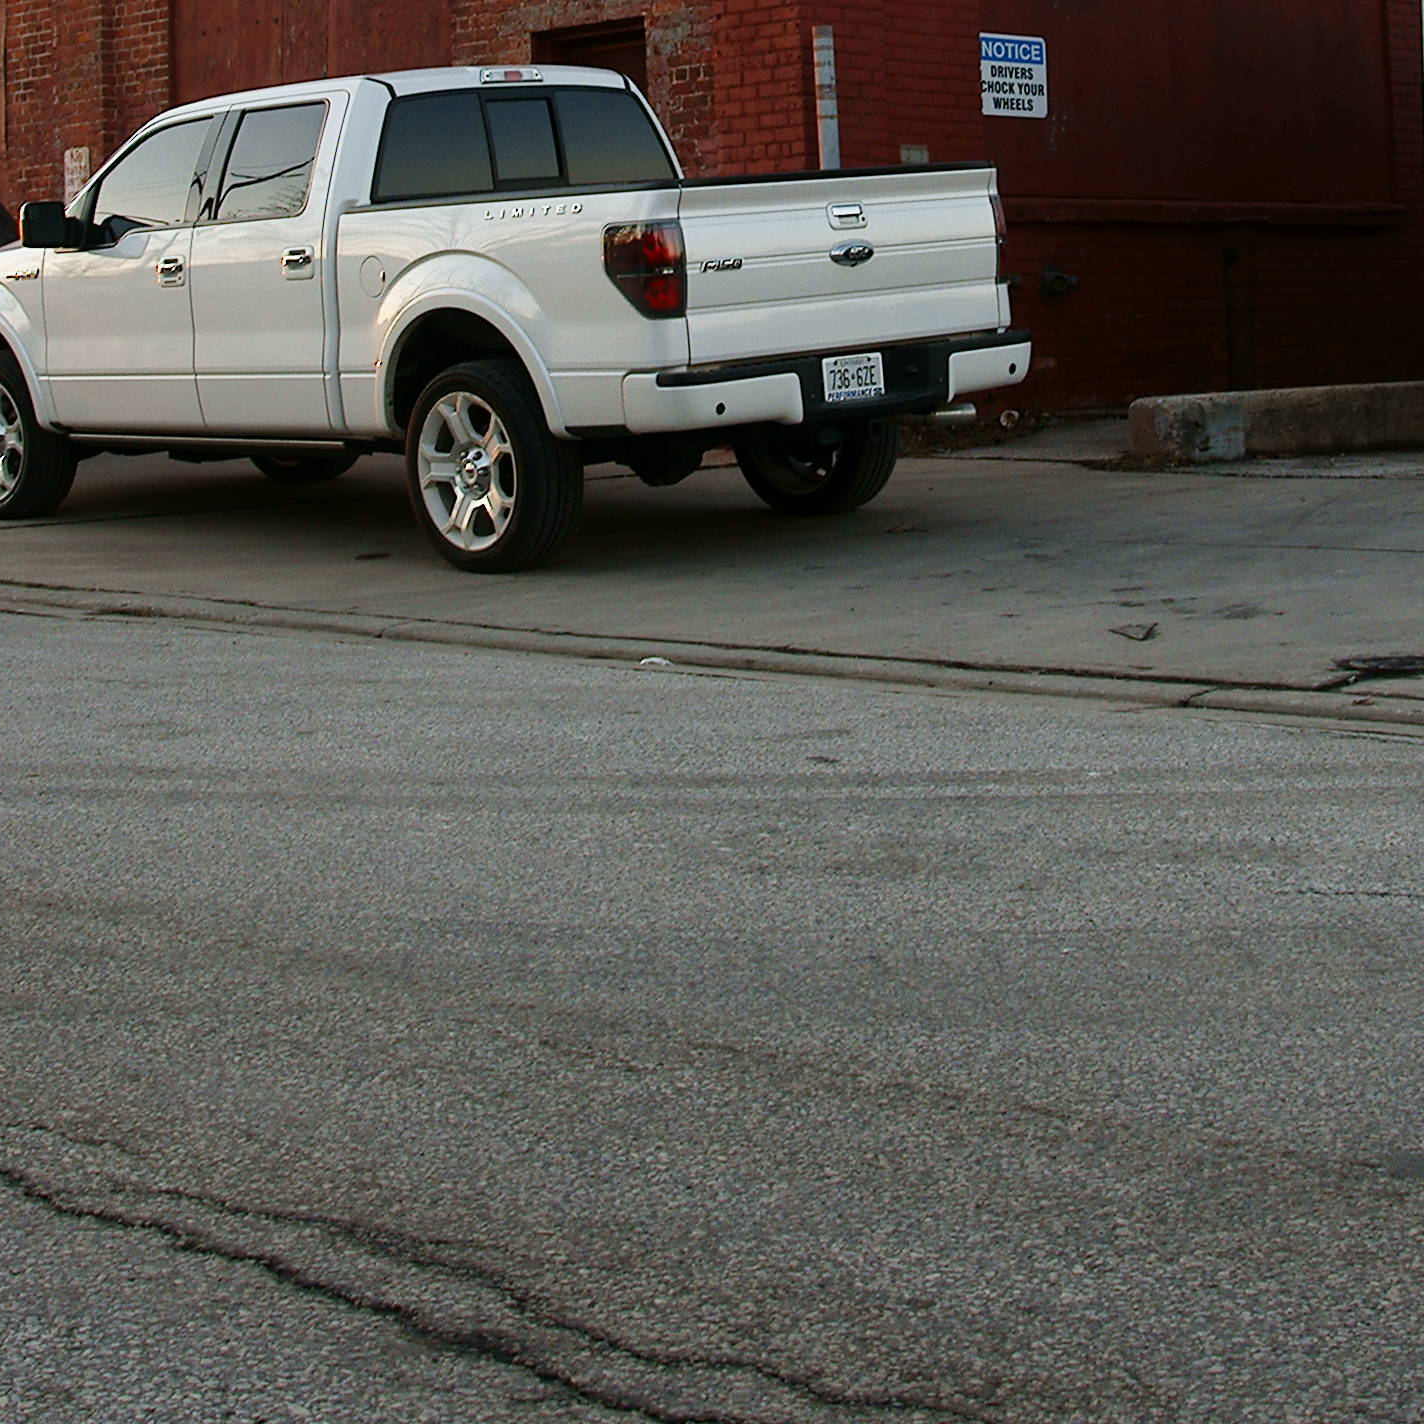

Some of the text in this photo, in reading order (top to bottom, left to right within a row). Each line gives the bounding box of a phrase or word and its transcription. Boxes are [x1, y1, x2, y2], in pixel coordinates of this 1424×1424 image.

[981, 40, 1041, 61] NOTICE
[990, 64, 1034, 80] DRIVERS
[980, 80, 1045, 96] CHOCK YOUR
[992, 97, 1034, 111] WHEELS
[484, 203, 583, 221] LIMITED
